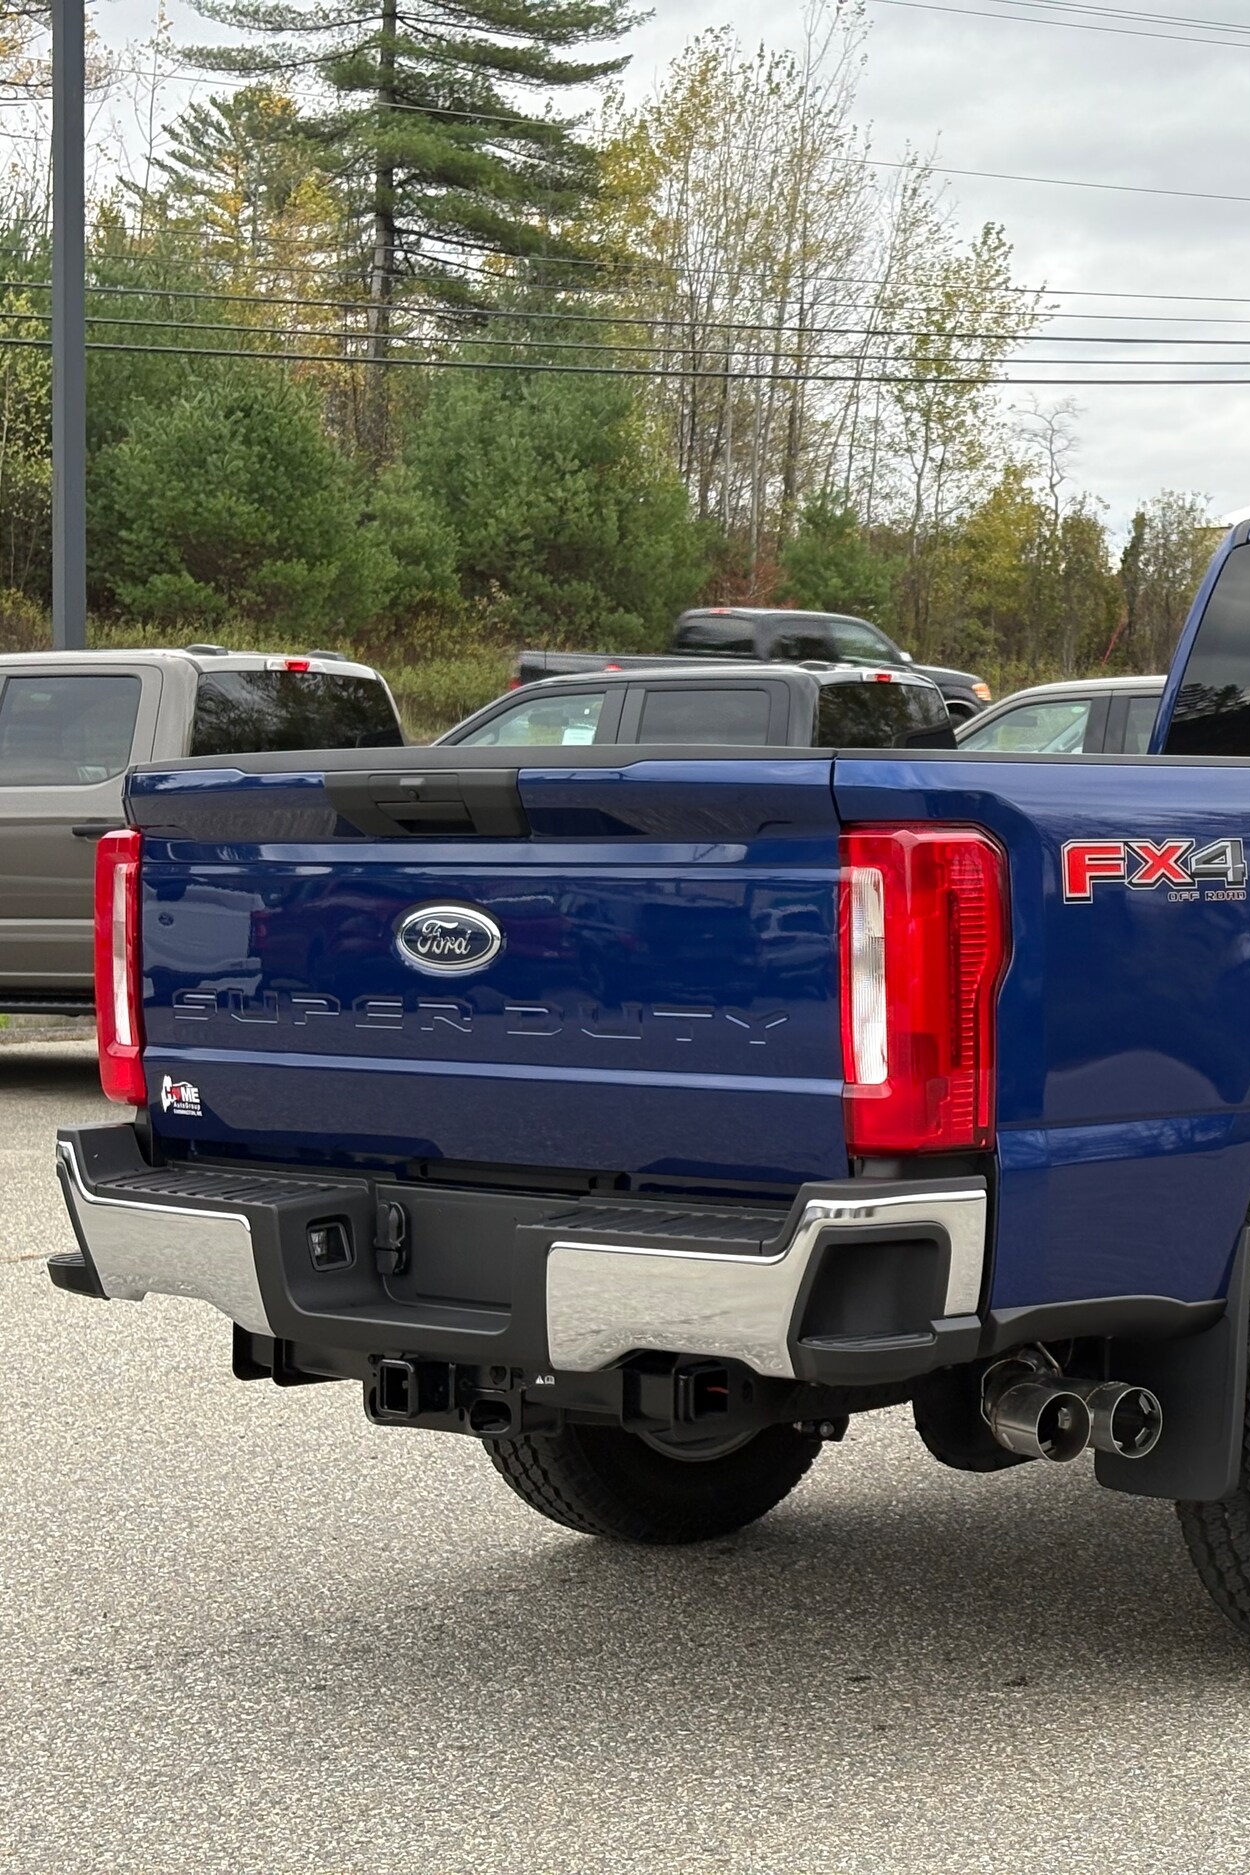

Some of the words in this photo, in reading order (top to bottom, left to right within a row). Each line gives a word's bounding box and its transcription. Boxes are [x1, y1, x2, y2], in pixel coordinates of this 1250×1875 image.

[1061, 838, 1248, 904] FX4
[1168, 891, 1200, 902] OFF
[1204, 890, 1247, 901] ROAD
[417, 919, 471, 954] Ford
[172, 988, 473, 1032] SUPER
[504, 1000, 789, 1045] DUTY
